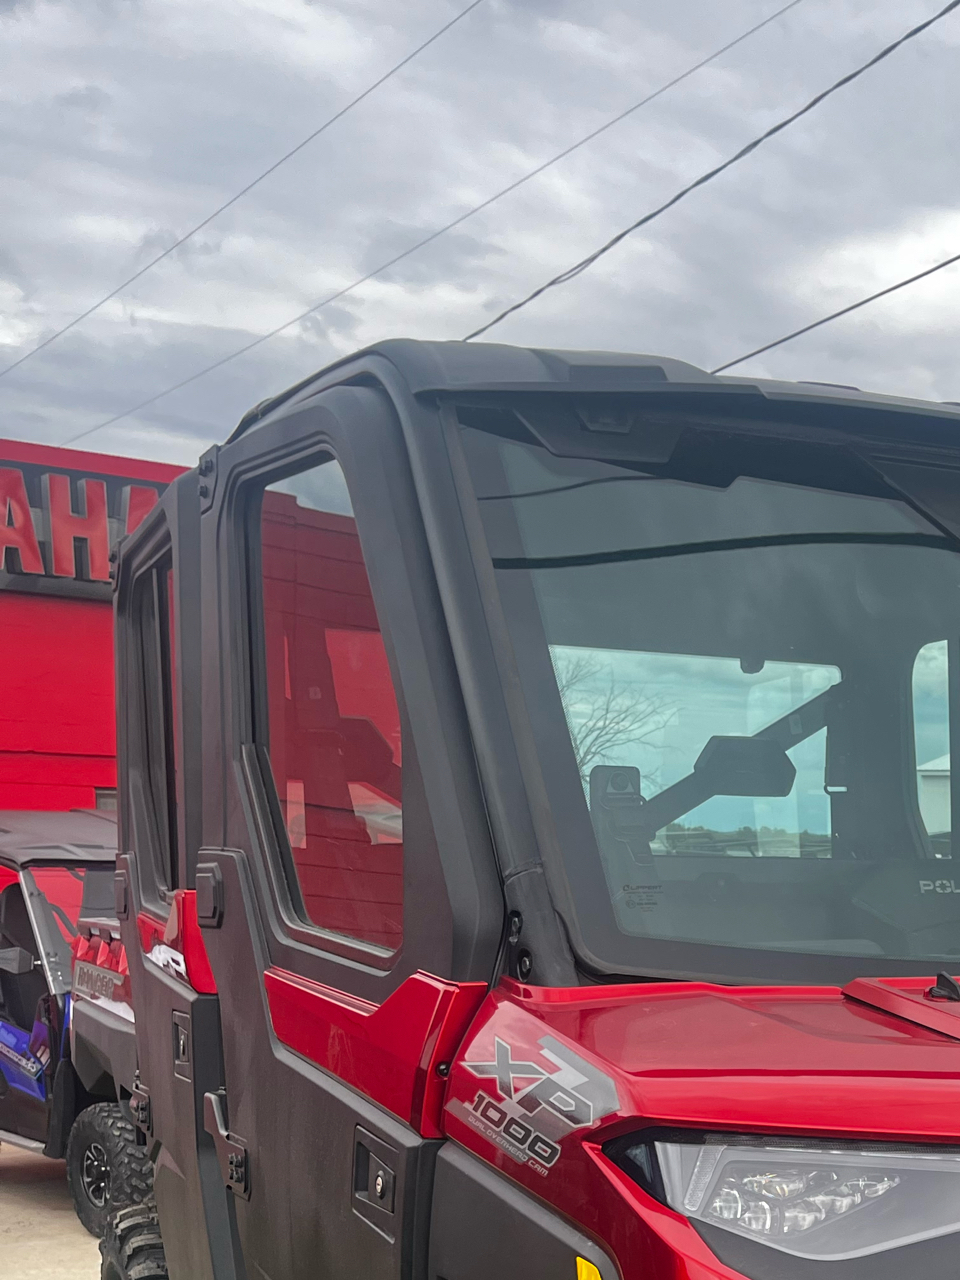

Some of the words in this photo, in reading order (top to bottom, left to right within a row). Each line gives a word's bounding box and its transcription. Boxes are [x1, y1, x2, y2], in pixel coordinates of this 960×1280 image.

[459, 1036, 593, 1128] XP
[467, 1115, 486, 1132] DUAL
[486, 1128, 529, 1162] OVERHEAD
[528, 1159, 549, 1177] CAM
[472, 1089, 561, 1168] 1000
